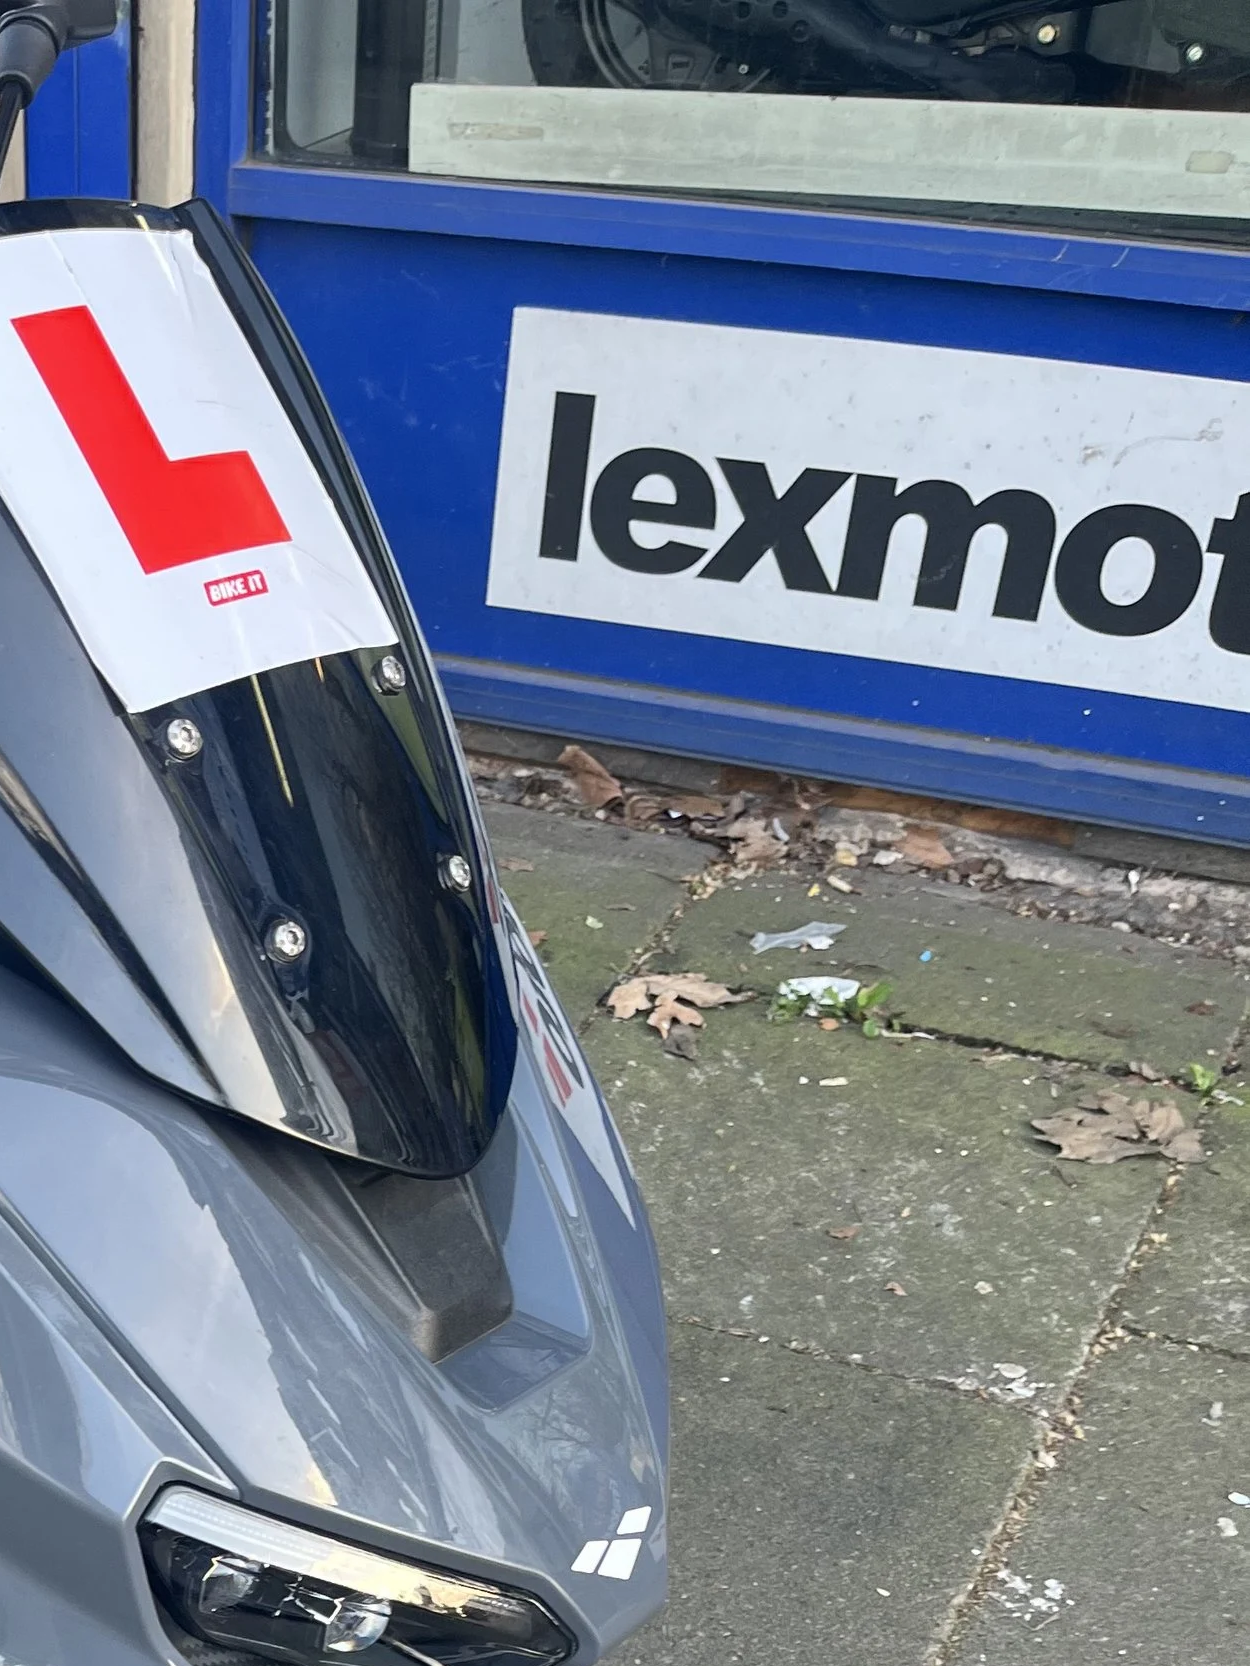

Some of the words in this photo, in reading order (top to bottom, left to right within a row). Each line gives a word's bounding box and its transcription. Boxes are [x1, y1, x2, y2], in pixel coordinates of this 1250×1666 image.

[10, 305, 293, 575] L
[208, 577, 248, 602] BIKE
[247, 574, 263, 592] IT
